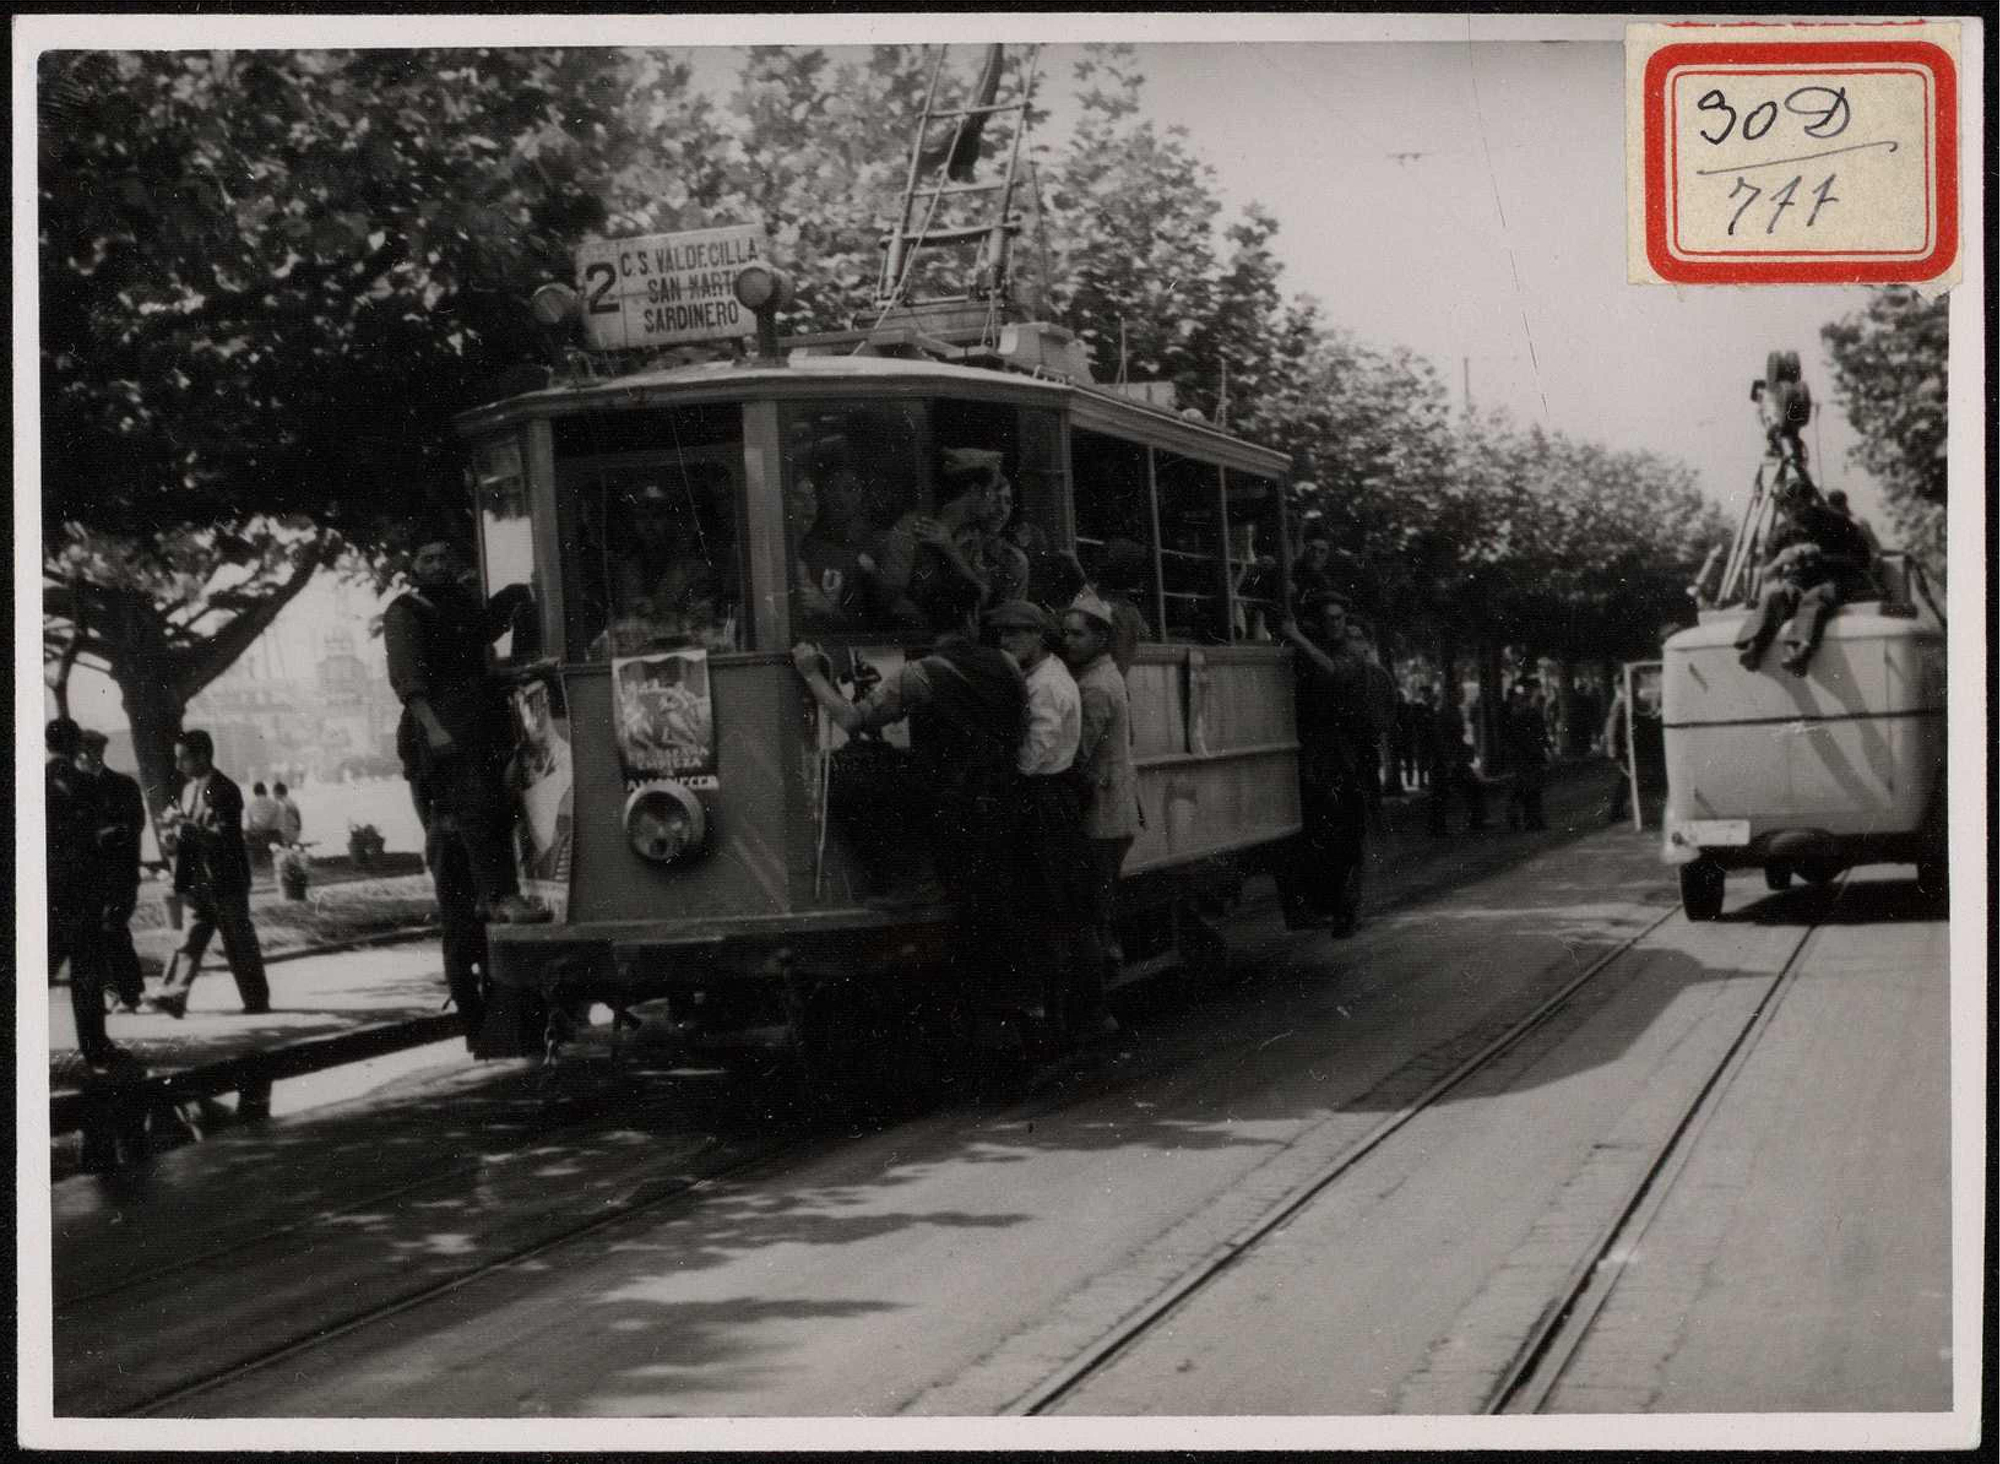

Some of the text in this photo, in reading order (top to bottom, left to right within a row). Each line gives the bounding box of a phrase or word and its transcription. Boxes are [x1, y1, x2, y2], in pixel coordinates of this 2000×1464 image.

[655, 237, 759, 275] VALDECILLA
[585, 261, 620, 315] 2
[647, 270, 738, 304] SAN MART
[643, 300, 739, 333] SARDINERO
